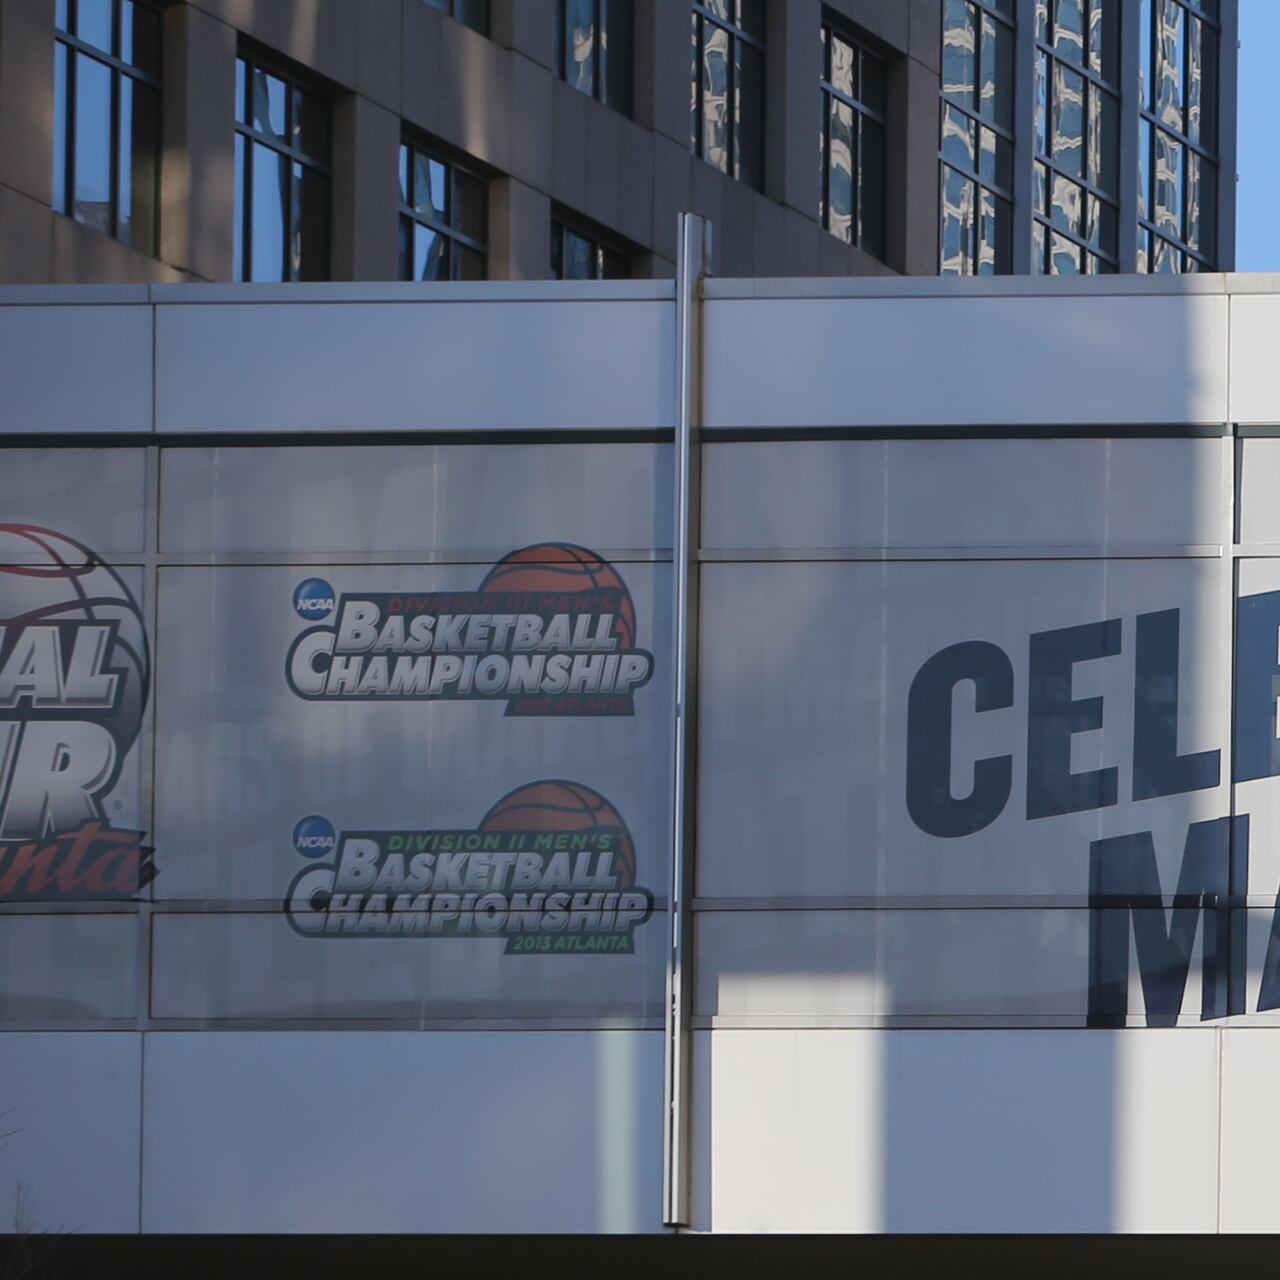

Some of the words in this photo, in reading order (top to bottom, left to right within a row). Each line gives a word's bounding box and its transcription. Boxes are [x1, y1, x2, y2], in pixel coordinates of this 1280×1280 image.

[296, 597, 336, 612] NCAA
[386, 595, 496, 612] DIVISION
[335, 599, 618, 653] BASKETBALL
[0, 624, 120, 709] AL
[291, 631, 650, 697] CHAMPIONSHIP
[296, 836, 336, 850] NCAA
[387, 834, 500, 851] DIVISION
[508, 834, 529, 850] II
[534, 833, 613, 851] MEN'S
[335, 838, 618, 892] BASKETBALL
[291, 868, 650, 934] CHAMPIONSHIP
[513, 936, 551, 951] 2013
[552, 935, 629, 951] ATLANTA
